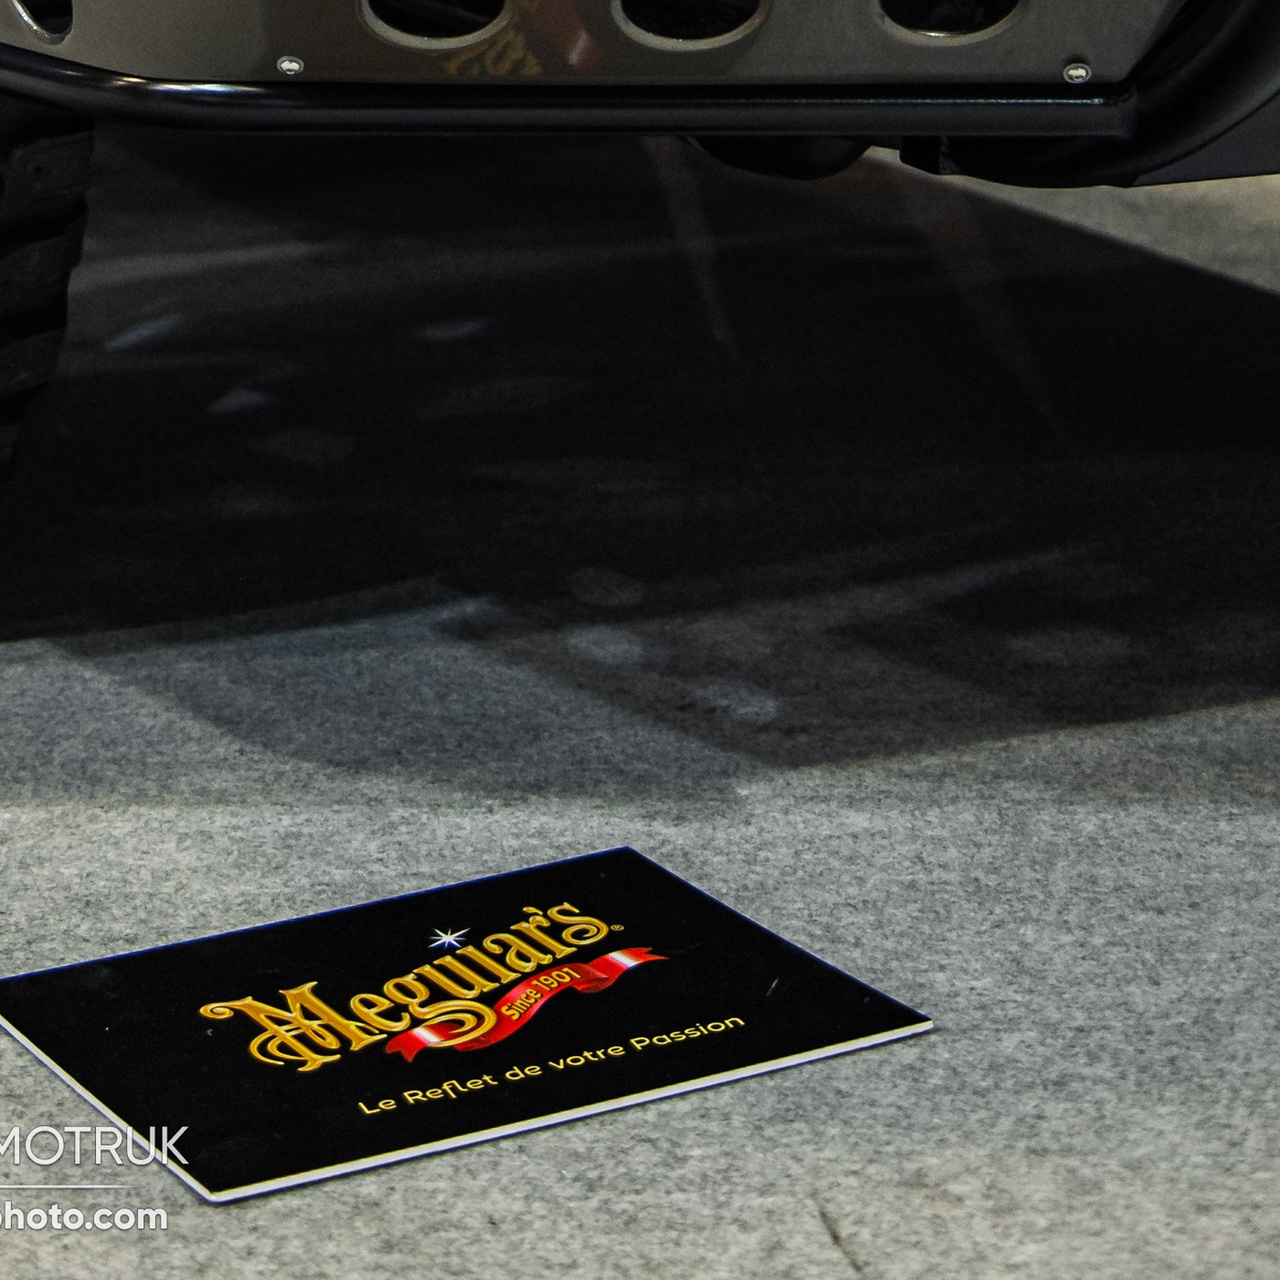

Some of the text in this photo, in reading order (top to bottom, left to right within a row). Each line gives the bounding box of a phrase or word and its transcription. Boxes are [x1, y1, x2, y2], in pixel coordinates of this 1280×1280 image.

[198, 901, 610, 1072] Meguiar's
[532, 966, 582, 992] 1901
[358, 1015, 746, 1116] Le Reflet de votre Passion
